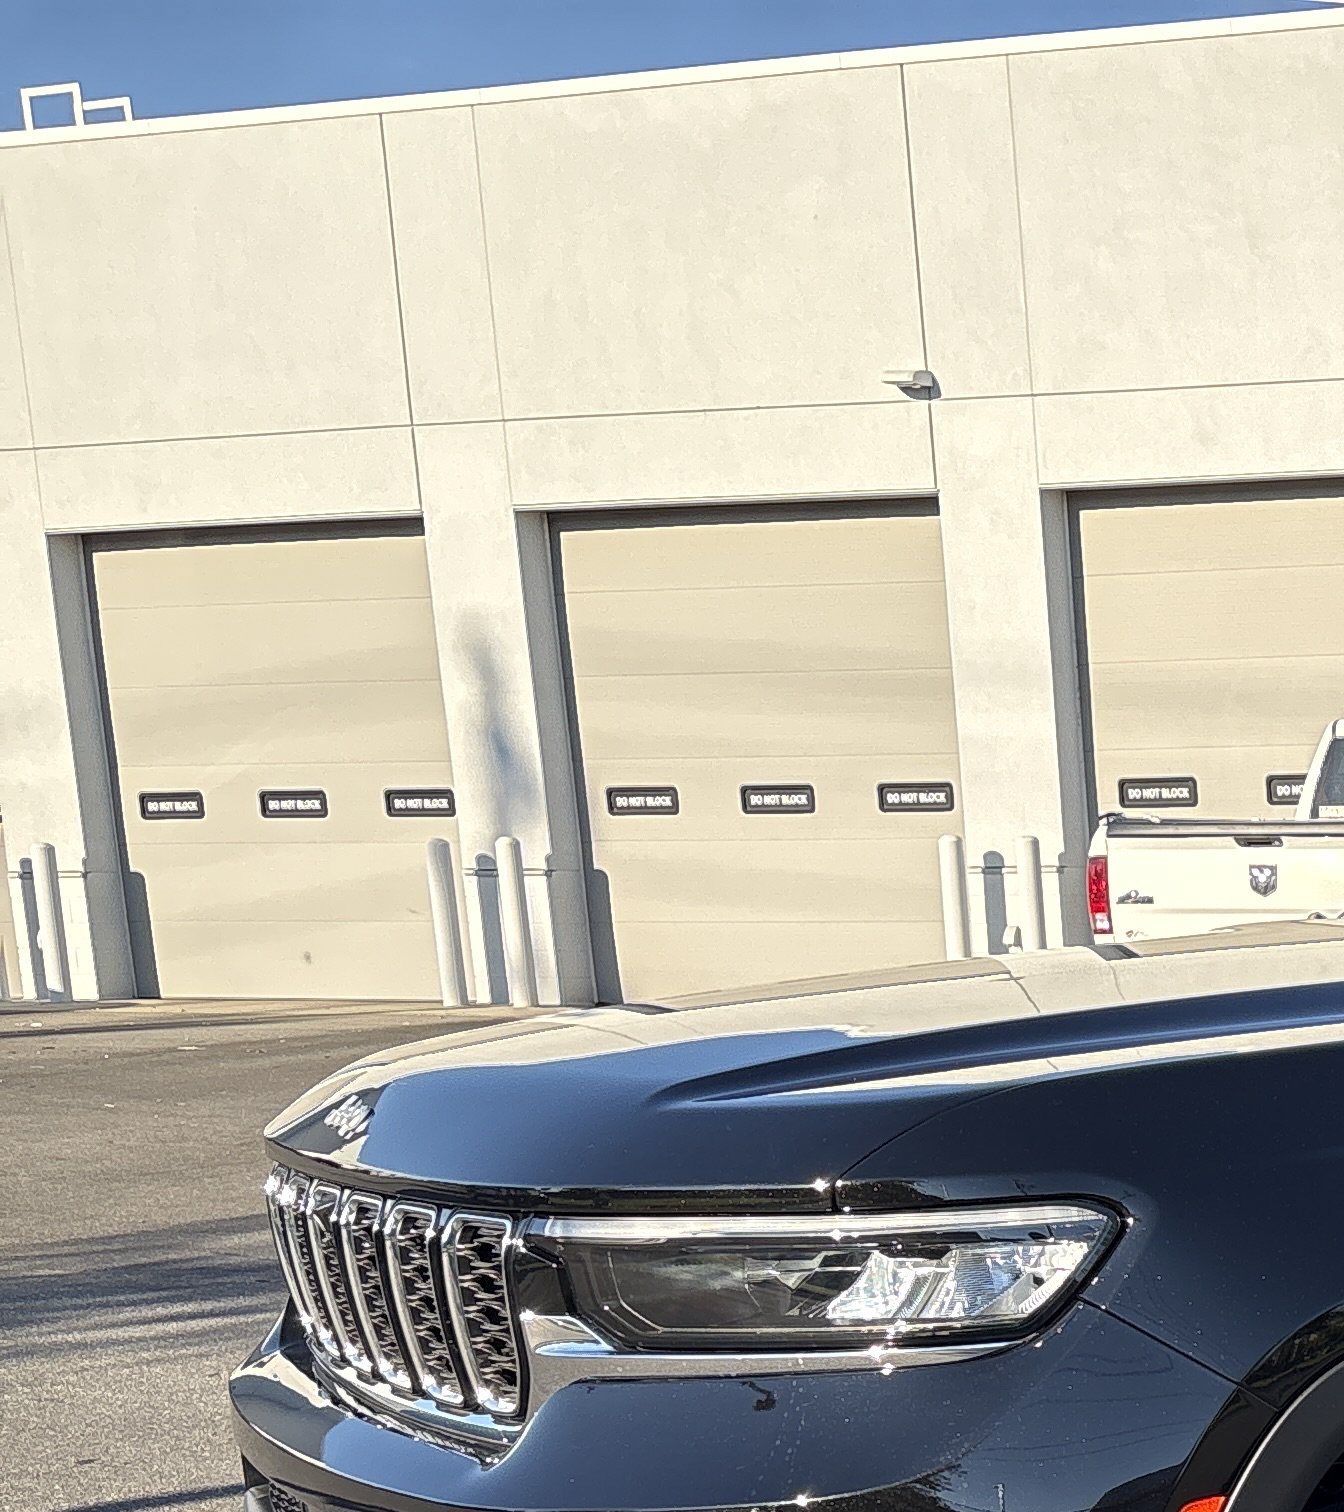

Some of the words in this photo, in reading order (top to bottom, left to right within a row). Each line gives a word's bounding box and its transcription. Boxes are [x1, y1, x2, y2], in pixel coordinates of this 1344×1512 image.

[1128, 787, 1142, 800] DO
[1142, 787, 1161, 800] NOT
[1161, 786, 1190, 800] BLOCK
[1277, 784, 1289, 797] DO
[1291, 784, 1303, 797] NO
[394, 798, 406, 809] DO
[407, 798, 422, 809] NOT
[424, 797, 449, 809] BLOCK
[616, 795, 628, 807] DO
[629, 795, 645, 807] NOT
[646, 794, 673, 807] BLOCK
[750, 794, 763, 806] DO
[764, 794, 781, 806] NOT
[781, 793, 809, 806] BLOCK
[887, 792, 900, 804] DO
[901, 792, 918, 804] NOT
[919, 791, 947, 804] BLOCK
[148, 801, 159, 812] DO
[159, 801, 174, 812] NOT
[174, 800, 199, 812] BLOCK
[269, 799, 280, 811] DO
[281, 799, 296, 811] NOT
[297, 798, 322, 811] BLOCK
